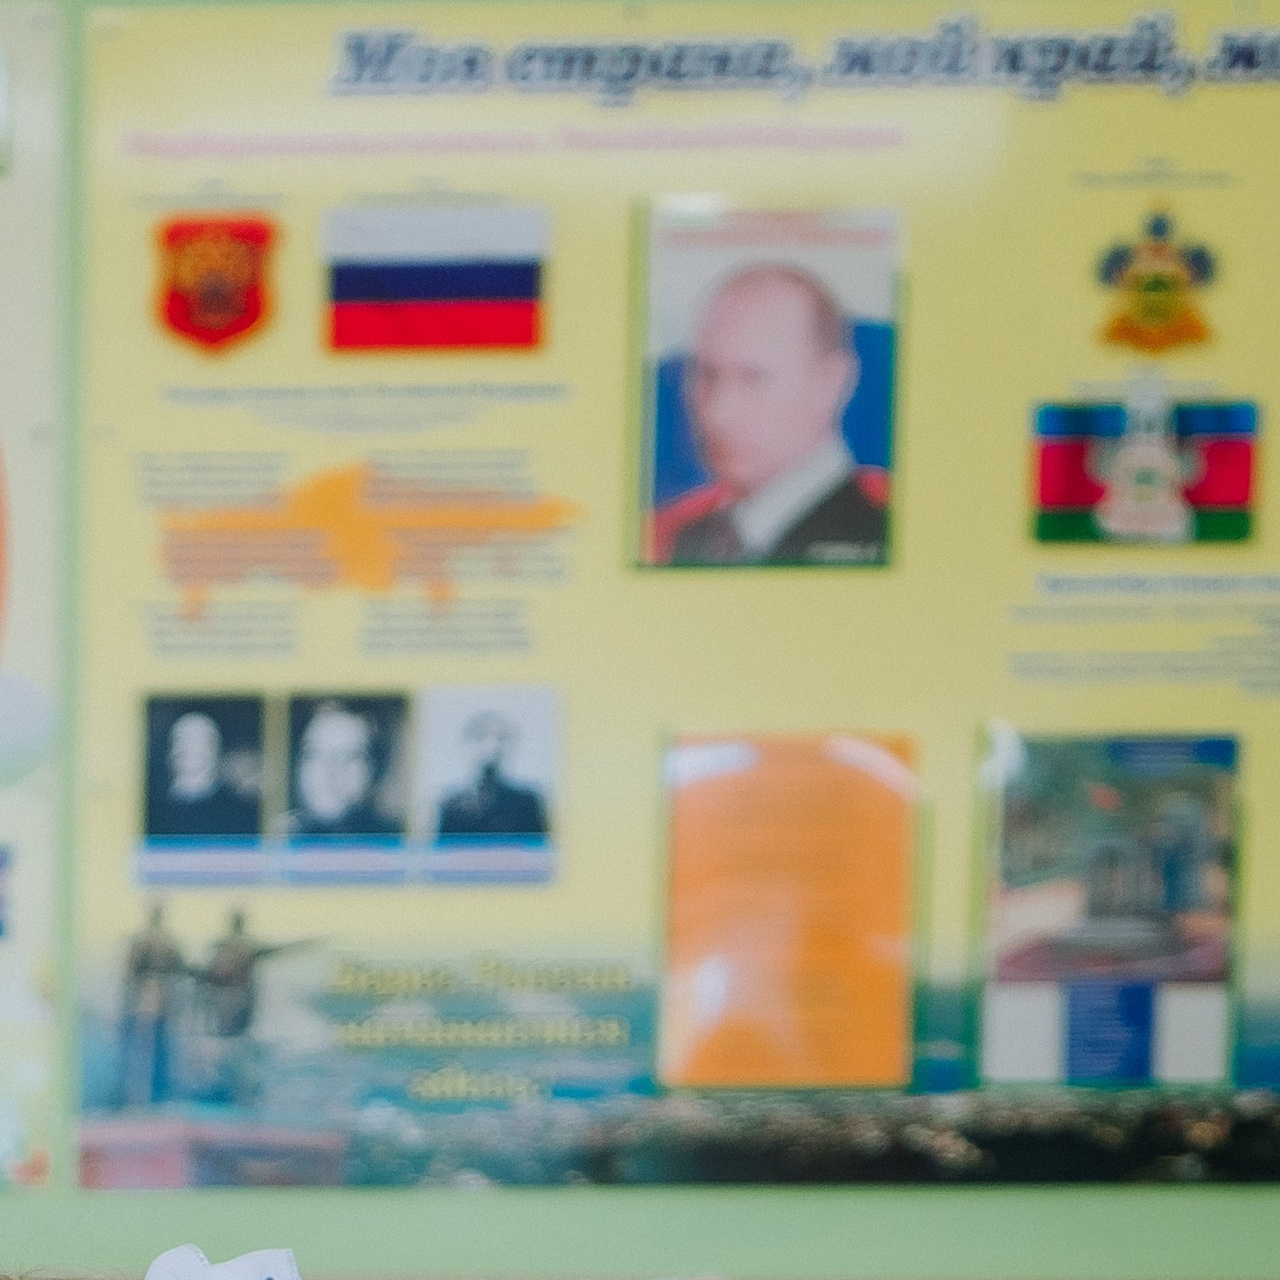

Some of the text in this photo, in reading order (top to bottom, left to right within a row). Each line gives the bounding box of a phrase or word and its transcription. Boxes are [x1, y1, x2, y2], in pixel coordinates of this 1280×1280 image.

[334, 32, 493, 84] Моя
[507, 40, 812, 106] страна,
[832, 20, 978, 80] мой
[993, 20, 1196, 99] край,
